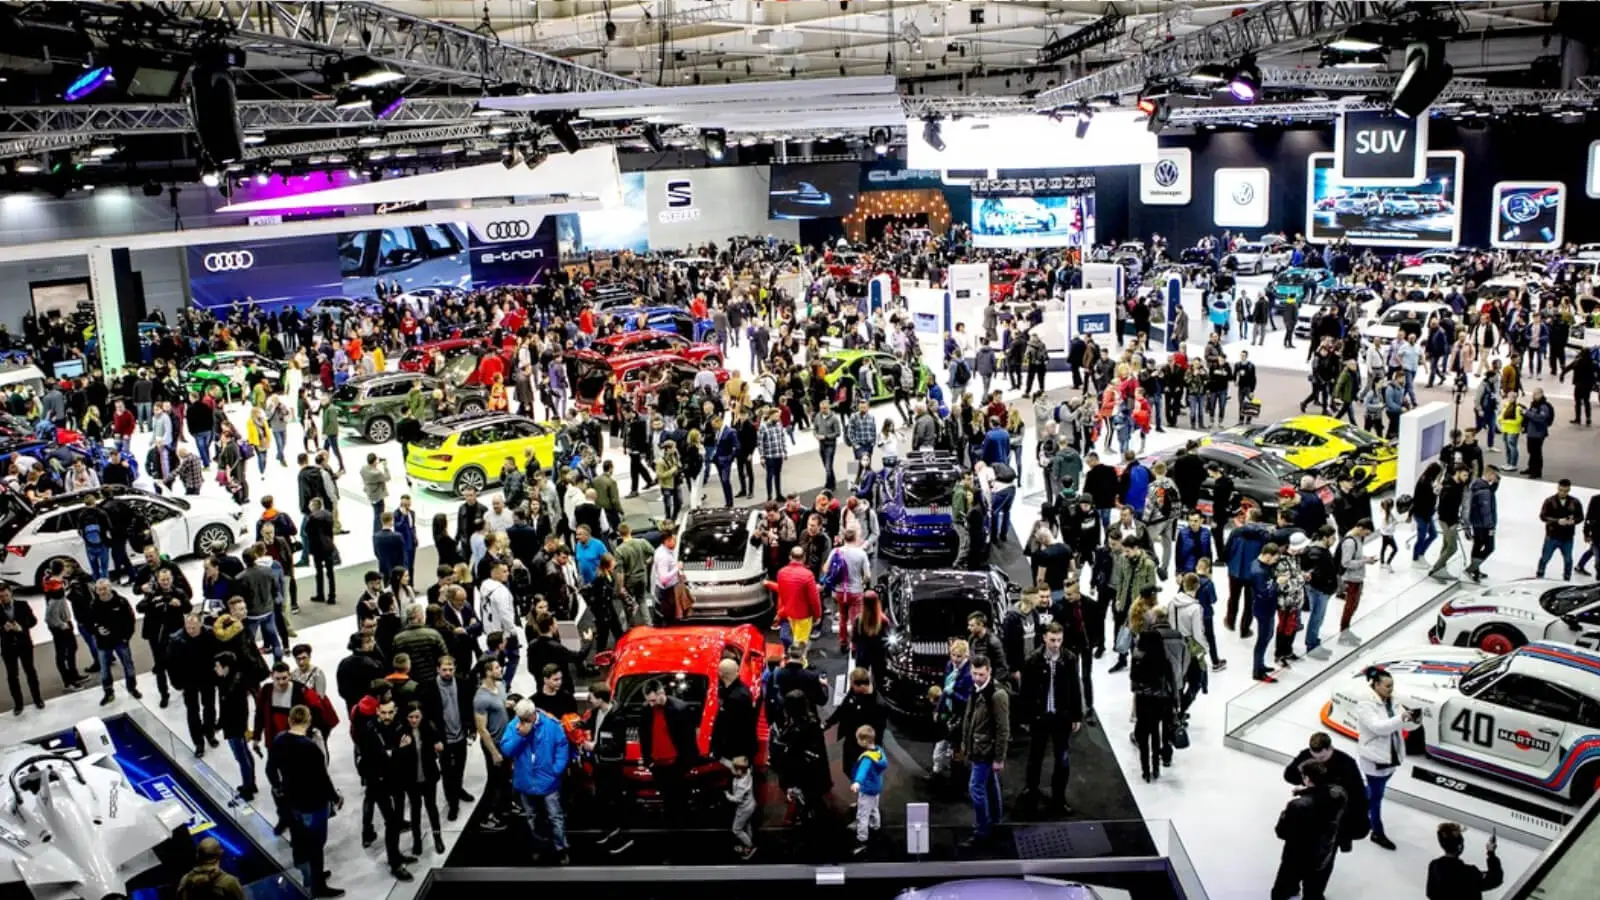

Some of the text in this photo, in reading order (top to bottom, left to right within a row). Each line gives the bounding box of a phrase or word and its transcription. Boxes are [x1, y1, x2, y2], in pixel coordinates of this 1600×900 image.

[1355, 130, 1407, 154] SUV
[481, 248, 543, 263] e-tron
[1450, 708, 1495, 748] 40
[1497, 728, 1550, 752] MARTINI
